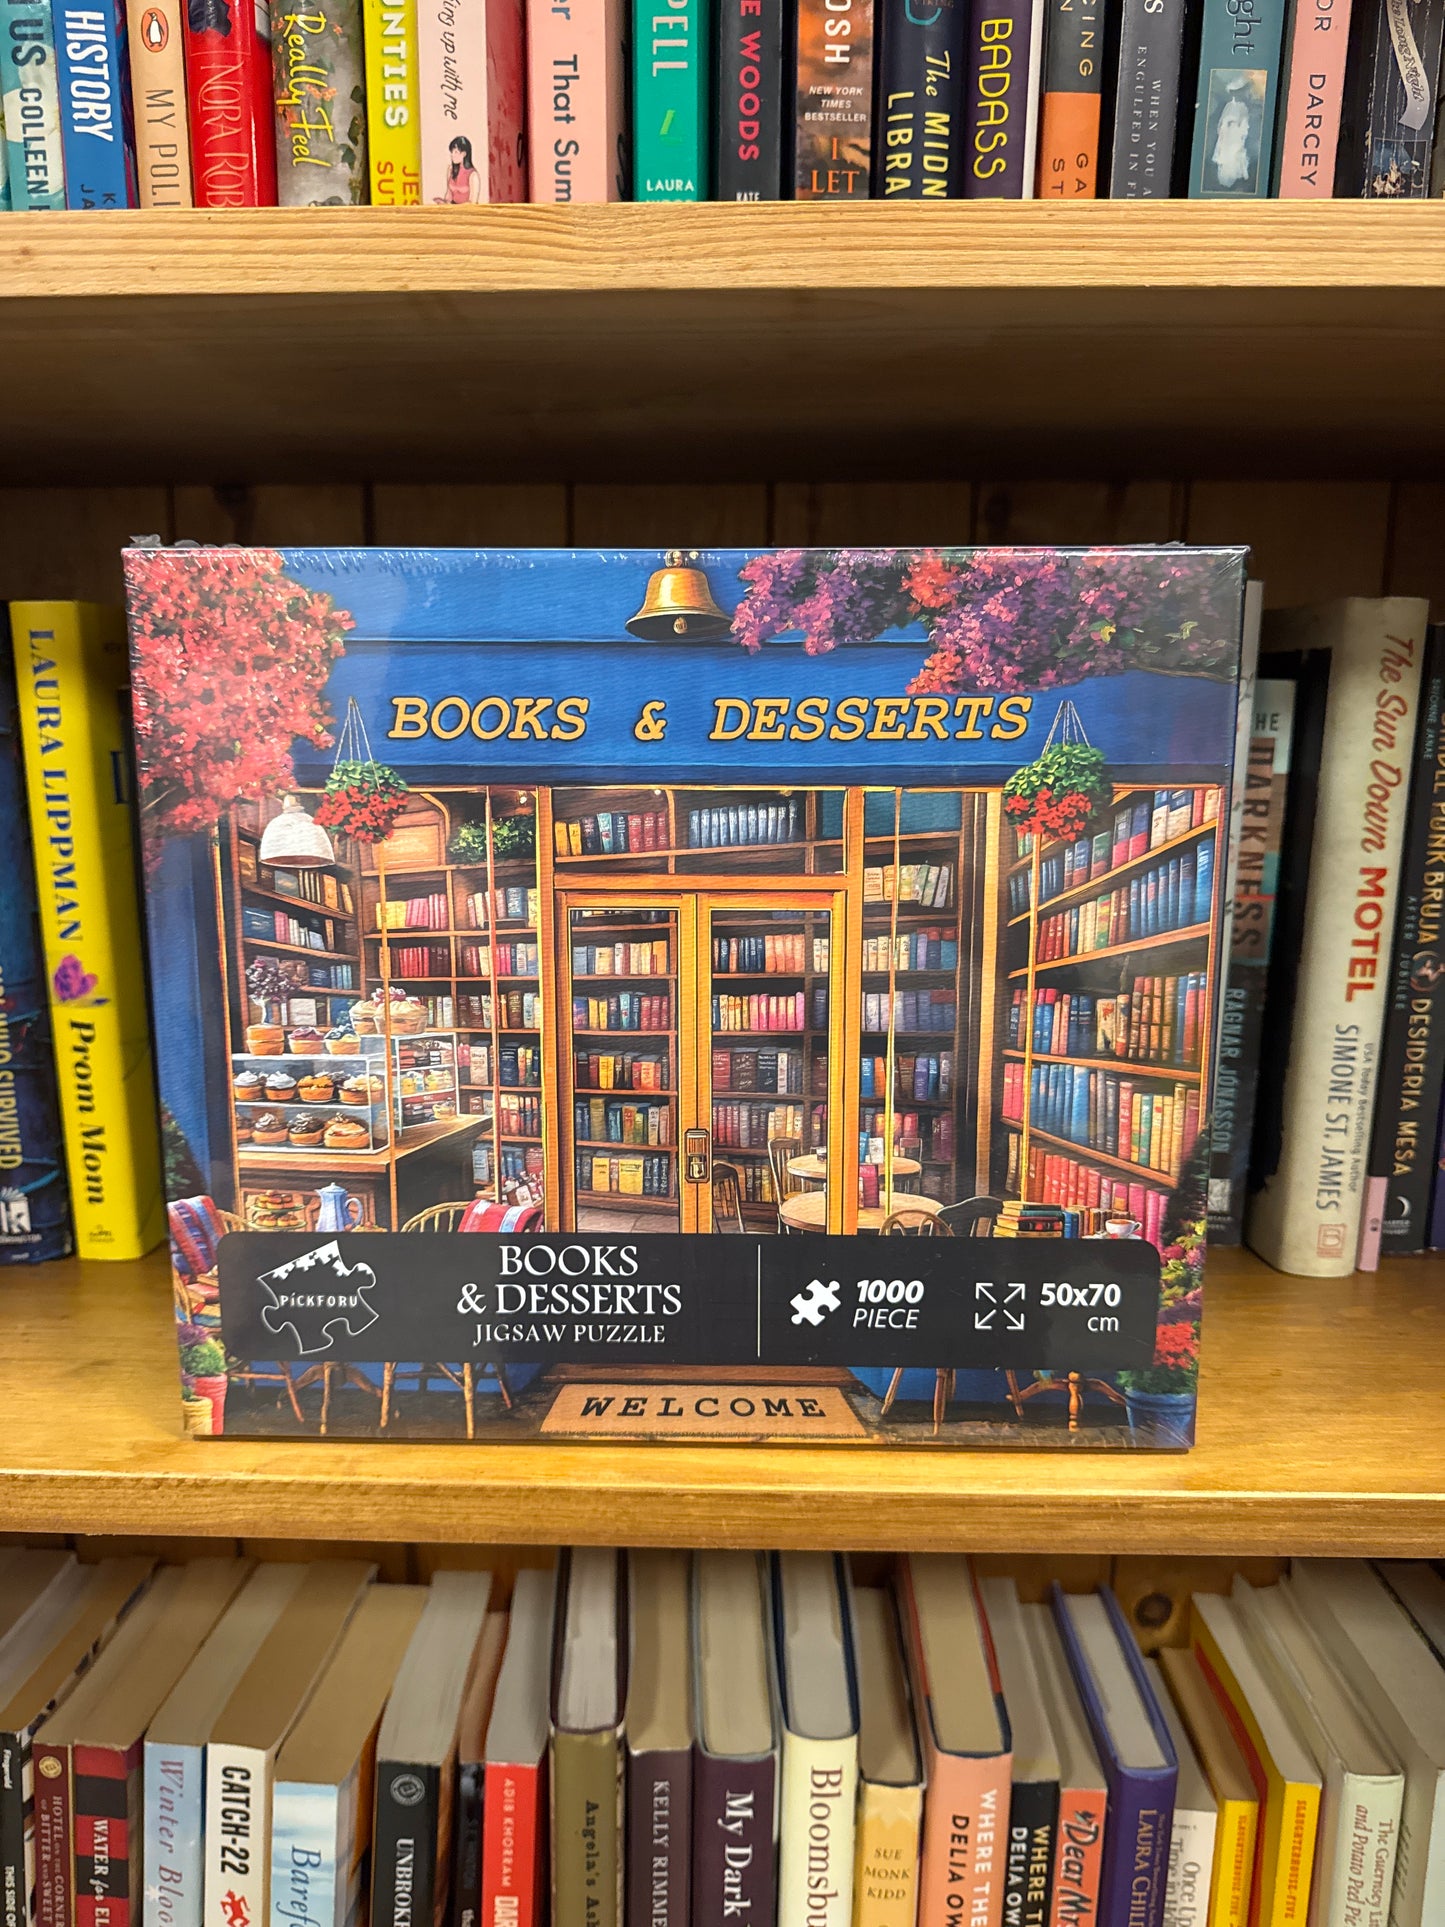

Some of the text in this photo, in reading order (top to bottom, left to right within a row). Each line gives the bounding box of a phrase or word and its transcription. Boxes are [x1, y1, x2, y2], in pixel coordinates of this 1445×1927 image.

[9, 19, 46, 67] US
[276, 12, 327, 105] Really
[382, 0, 408, 127] NTIES
[437, 0, 464, 120] ing up with me
[1079, 0, 1096, 77] ING
[65, 10, 114, 143] HISTORY
[200, 52, 244, 146] NORA
[552, 54, 580, 124] That
[738, 30, 761, 161] WOODS
[808, 85, 864, 96] NEW YORK
[924, 50, 951, 98] The
[973, 18, 1014, 180] BADASS
[1131, 46, 1148, 144] ENGULFED
[145, 89, 176, 129] MY
[804, 111, 867, 123] BESTSELLER
[820, 98, 852, 109] TIMES
[1148, 79, 1162, 132] WHEN
[19, 88, 49, 195] COLLEEN
[290, 106, 334, 168] Feel
[831, 137, 839, 161] I
[1300, 73, 1327, 188] DARCEY
[645, 178, 695, 193] LAURA
[810, 169, 861, 194] LET
[1128, 153, 1140, 171] IN
[1143, 141, 1157, 177] YOU
[386, 694, 1033, 742] BOOKS & DESSERTS
[1254, 712, 1281, 732] HE
[28, 629, 84, 942] LAURA LIPPMAN
[1344, 632, 1416, 1004] The Sun Down MOTEL
[1417, 871, 1445, 945] BRUJA
[1219, 987, 1248, 1060] RAGNAR
[68, 1018, 98, 1115] Prom
[1326, 1023, 1359, 1105] SIMONE
[1393, 998, 1433, 1177] DESIDERIA MESA
[1322, 1112, 1349, 1140] ST.
[80, 1120, 107, 1206] Mom
[1315, 1145, 1345, 1211] JAMES
[498, 1243, 640, 1277] BOOKS
[456, 1282, 683, 1316] & DESSERTS
[856, 1278, 925, 1305] 1000
[1039, 1281, 1123, 1308] 50x70
[472, 1322, 666, 1347] JIGSAW PUZZLE
[852, 1307, 921, 1330] PIECE
[1086, 1312, 1120, 1333] cm
[580, 1396, 827, 1419] WELCOME
[52, 1795, 64, 1840] HOTEL
[158, 1759, 186, 1854] Winter
[220, 1764, 252, 1876] CATCH-22
[652, 1780, 671, 1848] KELLY
[1354, 1803, 1373, 1834] and
[1377, 1819, 1394, 1846] The
[40, 1813, 52, 1863] BITTER
[93, 1819, 109, 1876] WATER
[582, 1800, 600, 1888] Angela's
[716, 1789, 756, 1919] My Dark
[873, 1847, 903, 1860] SUE
[946, 1813, 971, 1884] DELIA
[969, 1788, 998, 1927] WHERE THE
[1006, 1826, 1029, 1889] DELIA
[1026, 1824, 1051, 1904] WHERE
[1060, 1820, 1100, 1889] Dear
[1134, 1808, 1159, 1872] LAURA
[1349, 1832, 1370, 1876] Potato
[4, 1864, 16, 1889] THIS
[89, 1878, 110, 1901] for
[864, 1866, 911, 1880] MONK
[866, 1886, 907, 1901] KIDD
[1180, 1861, 1201, 1903] Once
[1346, 1876, 1366, 1906] Peel
[1364, 1847, 1390, 1908] Guernsey
[5, 1888, 16, 1912] SIDE
[42, 1880, 53, 1923] SWEET
[54, 1874, 65, 1927] CORNER
